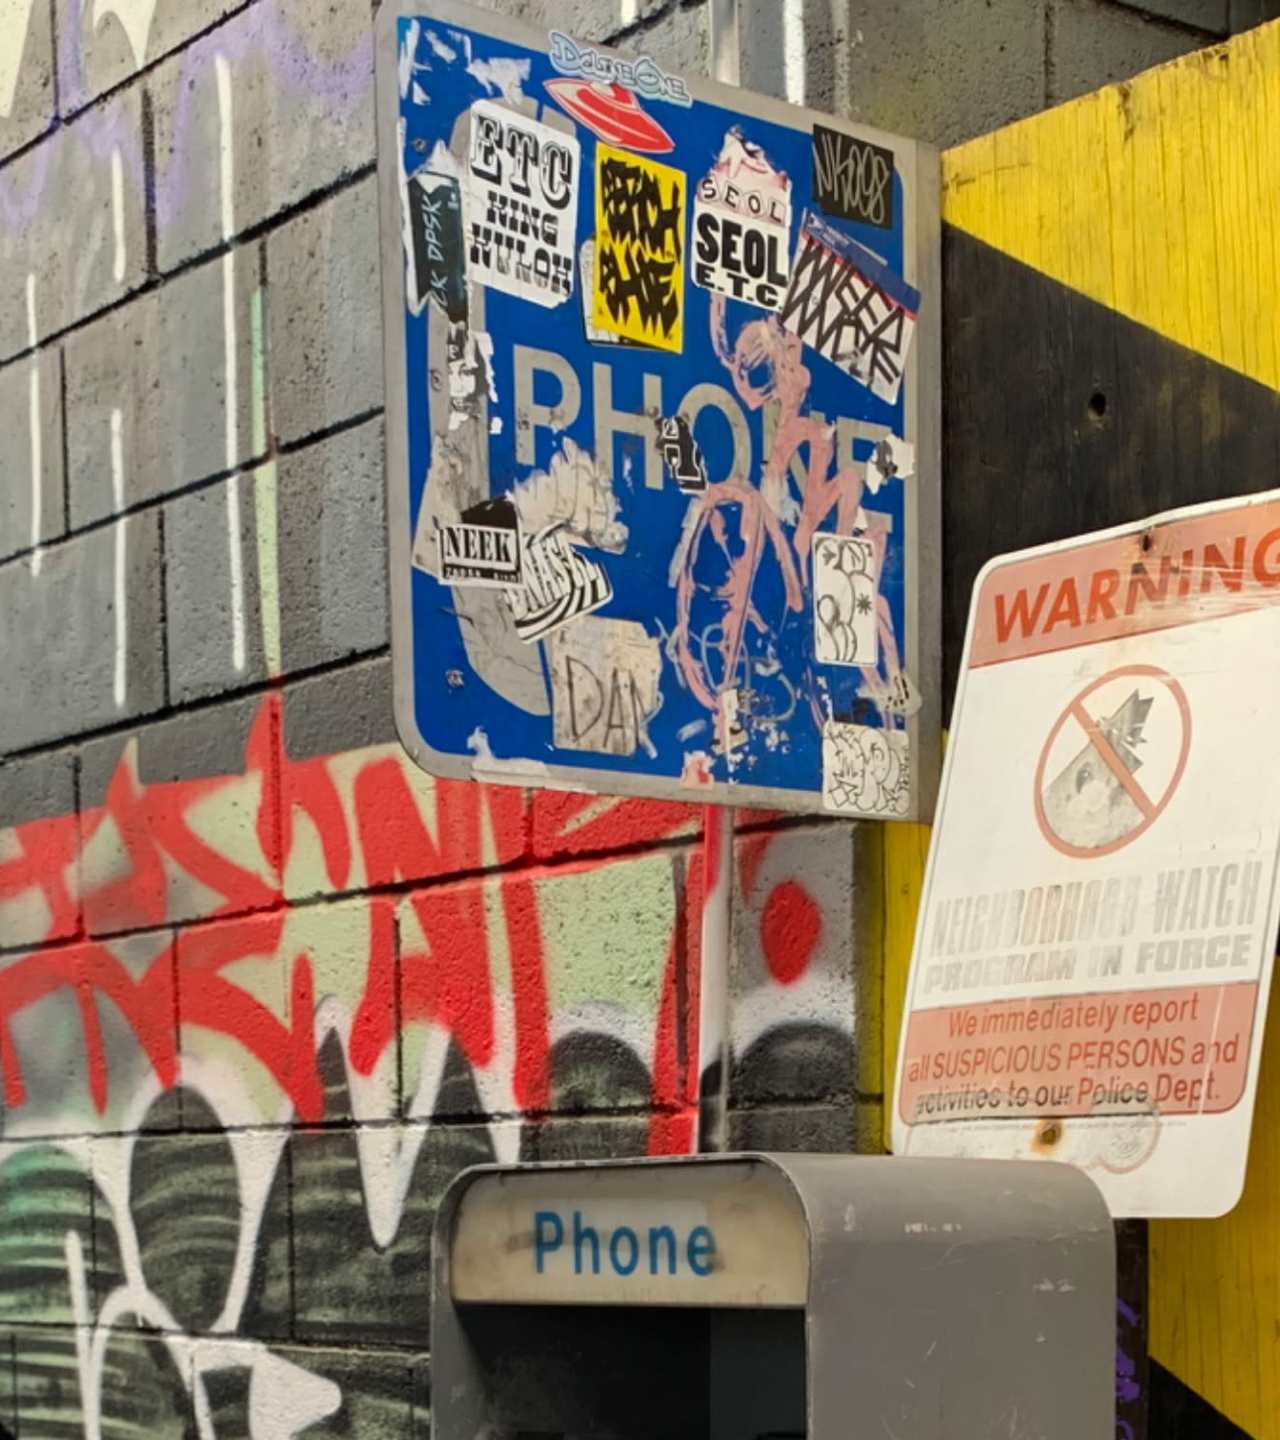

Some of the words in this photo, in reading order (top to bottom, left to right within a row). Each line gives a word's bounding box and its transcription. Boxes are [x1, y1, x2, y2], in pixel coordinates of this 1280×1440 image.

[471, 115, 574, 210] ETC
[486, 190, 559, 247] KING
[702, 177, 782, 224] SEOL
[696, 213, 788, 288] SEOL
[445, 526, 511, 564] NEEK
[1152, 861, 1263, 935] WATCH
[924, 950, 1078, 994] PROGRAM
[1087, 944, 1123, 978] IN
[1136, 934, 1254, 976] FORCE
[948, 1011, 978, 1038] We
[980, 1001, 1121, 1035] immediately
[1122, 992, 1199, 1030] report
[908, 1056, 930, 1083] all
[931, 1042, 1062, 1081] SUSPICIOUS
[1066, 1036, 1186, 1070] PERSONS
[1191, 1034, 1240, 1063] and
[916, 1082, 1001, 1116] activities
[1006, 1080, 1030, 1108] to
[1034, 1084, 1073, 1107] our
[1077, 1077, 1149, 1106] Police
[532, 1209, 720, 1277] Phone
